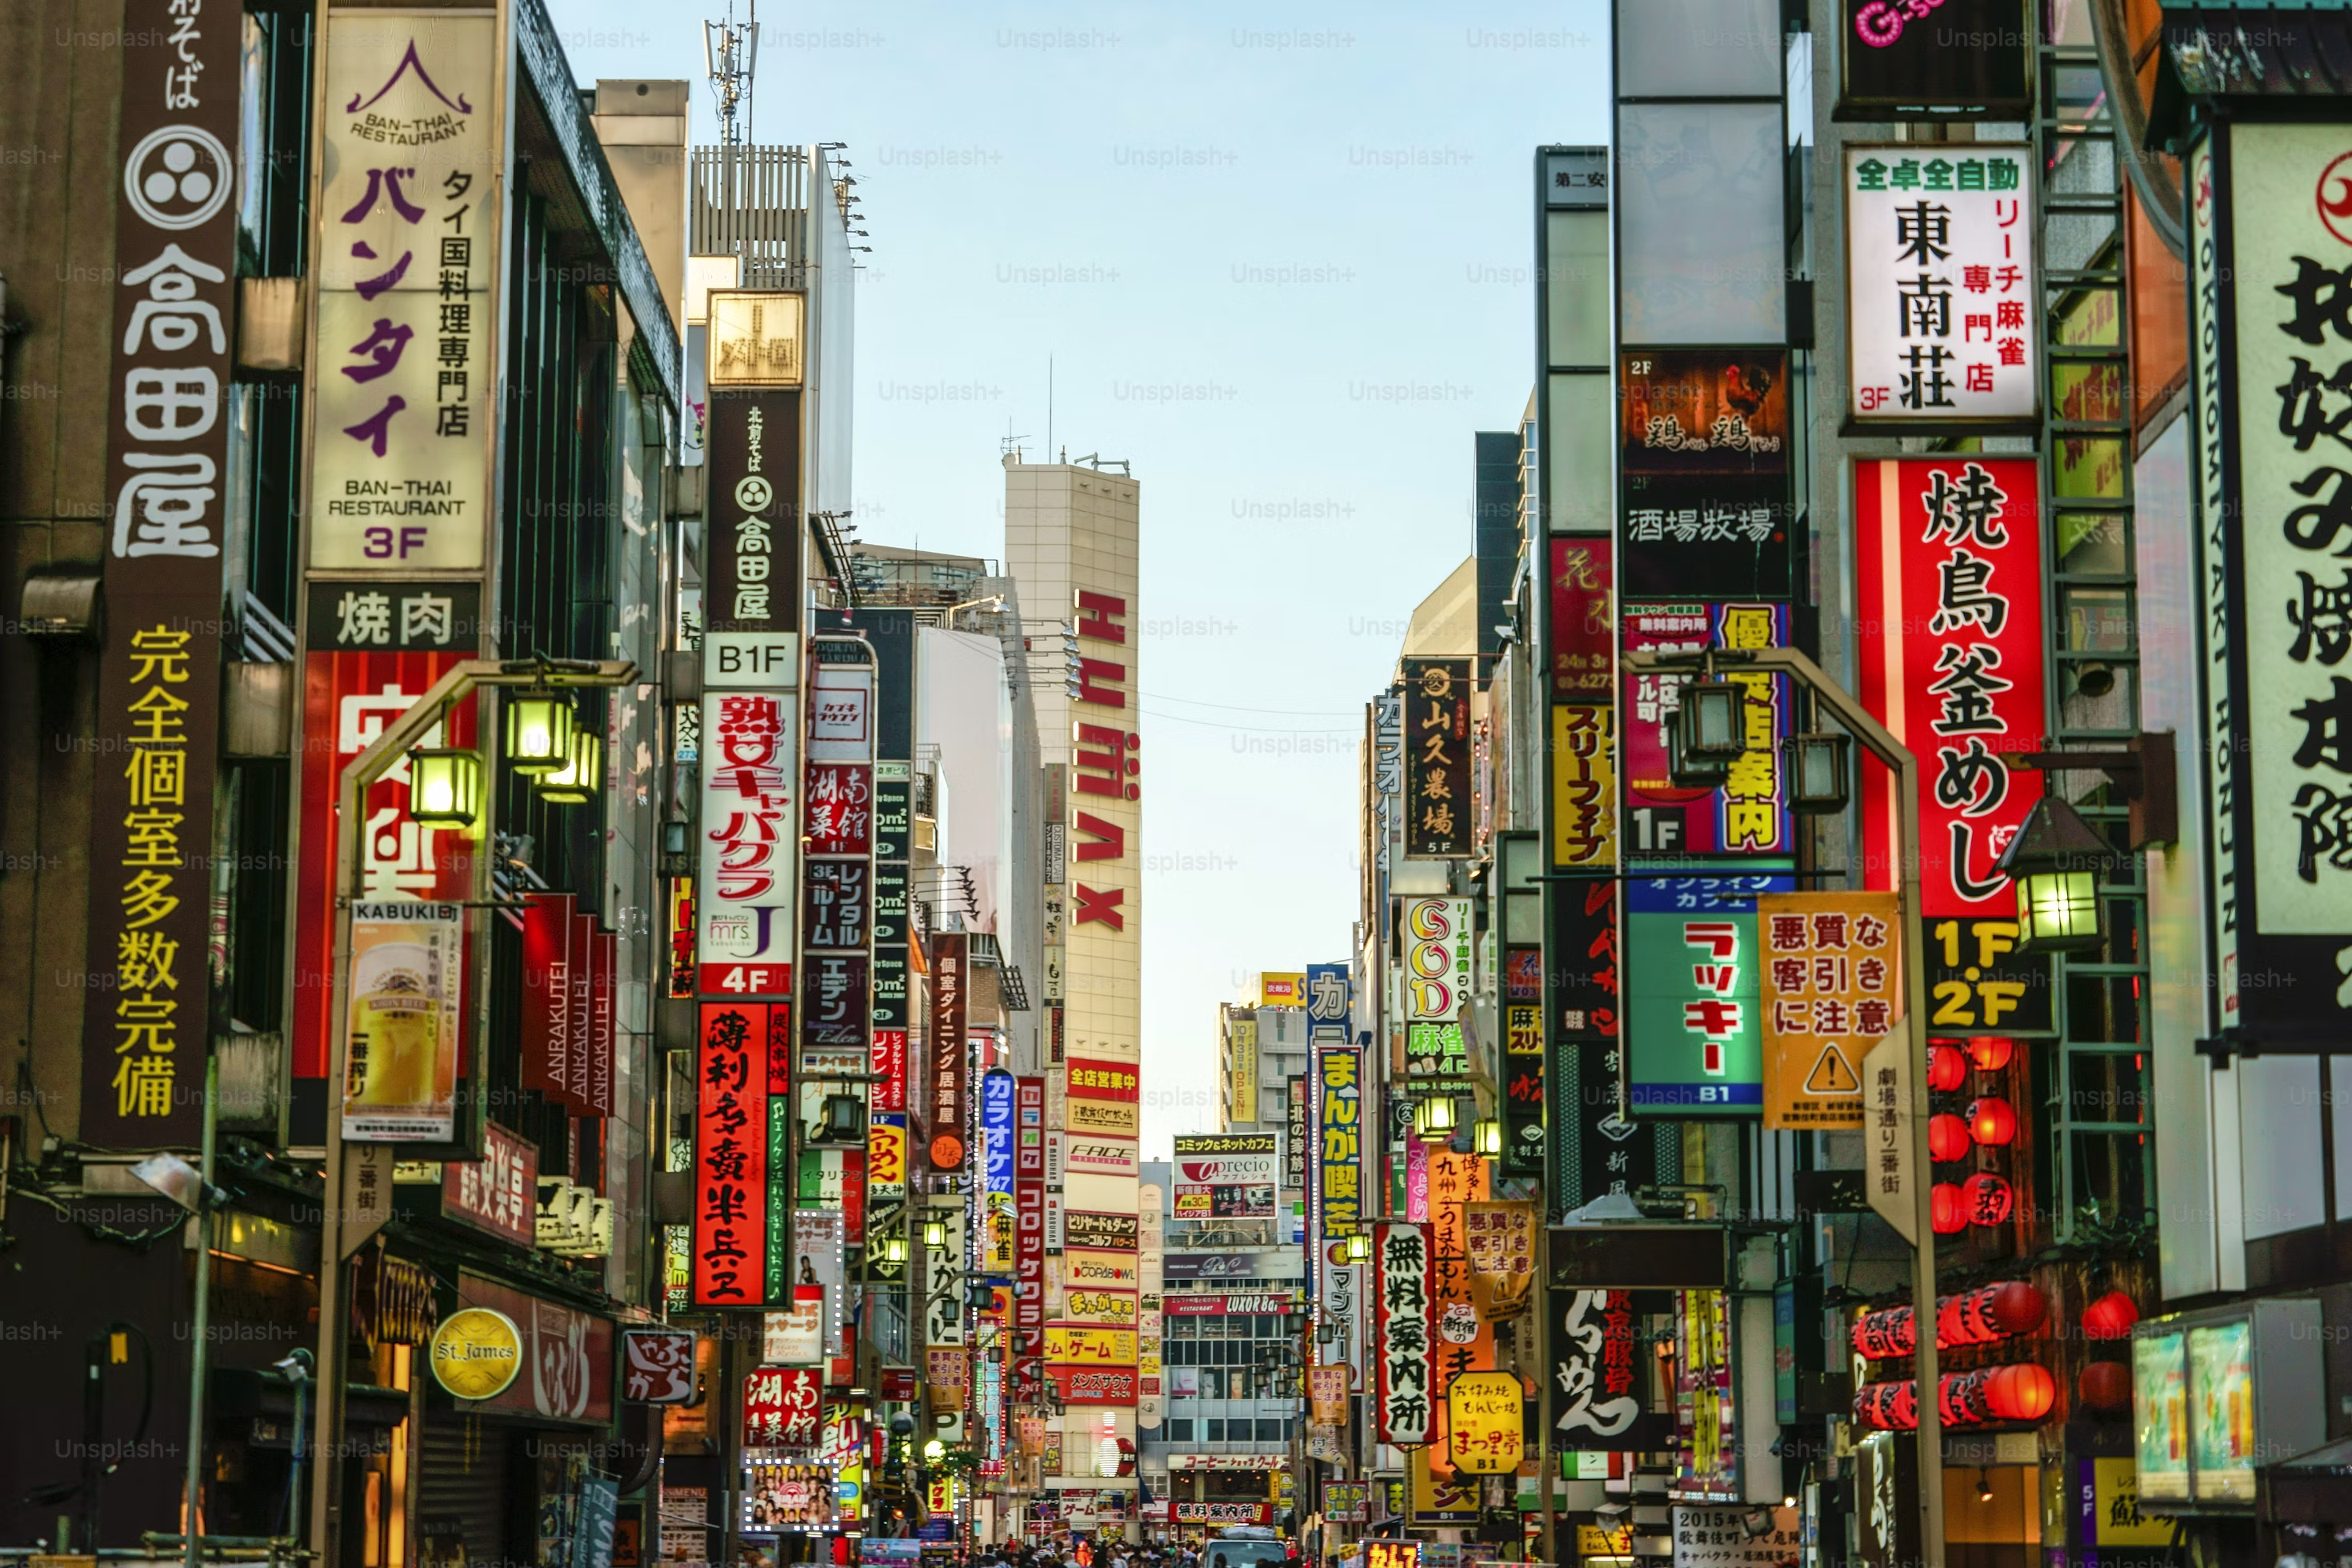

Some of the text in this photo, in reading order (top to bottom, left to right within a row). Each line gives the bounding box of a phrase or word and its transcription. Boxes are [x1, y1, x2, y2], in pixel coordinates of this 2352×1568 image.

[350, 120, 468, 146] RESTAURANT
[364, 113, 453, 133] BAN-THAI
[1856, 158, 2019, 192] 全卓全自動
[1994, 199, 2026, 367] リーチ麻雀
[340, 166, 426, 458] バンタイ
[436, 170, 473, 438] タイ国料理専門店
[1894, 198, 1956, 410] 東南荘
[1963, 265, 1994, 394] 専門店
[1631, 360, 1652, 375] 2F
[112, 243, 226, 558] 高田屋
[1860, 386, 1890, 411] 3F
[748, 406, 762, 472] 北前そば
[346, 480, 452, 496] BAN-THAI
[329, 501, 465, 516] RESTAURANT
[1628, 508, 1776, 542] 酒場牧場
[364, 527, 427, 558] 3F
[735, 515, 771, 619] 高田屋
[336, 590, 453, 646] 焼肉
[1638, 618, 1708, 632] 無料案内所
[720, 646, 785, 673] B1F
[1922, 462, 2013, 902] 焼鳥釜めし
[1421, 701, 1455, 835] 山久農場
[1566, 707, 1607, 863] スリーファイブ
[709, 696, 790, 901] 熟女キャバクラ
[808, 768, 868, 804] 湖南
[1632, 807, 1680, 850] 1F
[878, 844, 891, 854] 5F
[1427, 842, 1452, 853] 5F
[111, 624, 191, 1118] 完全個室多数完備
[812, 885, 834, 946] ルーム
[839, 864, 863, 946] レンタル
[877, 926, 890, 936] 4F
[1456, 902, 1470, 973] リーチ麻雀
[1770, 914, 1889, 952] 悪質な
[1934, 919, 2020, 968] 1F
[722, 966, 768, 993] 4F
[821, 960, 847, 1020] エデン
[1771, 957, 1889, 994] 客引き
[876, 1010, 890, 1019] 3F
[1684, 921, 1743, 1077] ラッキー
[1932, 980, 2026, 1027] 2F
[548, 962, 567, 1083] ANRAKUTEI
[1773, 998, 1891, 1038] に注意
[938, 957, 957, 1124] 個室ダイニング居酒屋
[1408, 1023, 1468, 1056] 麻雀
[350, 1032, 370, 1098] 一番搾り
[1070, 1068, 1136, 1091] 全店営業中
[1699, 1086, 1730, 1102] B1
[986, 1076, 1012, 1173] カラオケ
[1021, 1086, 1041, 1170] カラオケ
[1290, 1106, 1304, 1172] 北の家族
[1877, 1066, 1901, 1195] 劇場通り一番街
[1070, 1145, 1136, 1159] FACE
[1176, 1138, 1274, 1151] コミック&ネットカフェ
[1324, 1054, 1358, 1237] まんが喫茶
[1176, 1185, 1211, 1195] 新宿最大
[1068, 1215, 1137, 1234] ビリヤード&ダーツ
[1175, 1209, 1211, 1218] ハイジアB1
[1468, 1211, 1528, 1231] 悪質な
[996, 1215, 1012, 1262] 麻雀
[1089, 1234, 1112, 1247] ゴルフ
[1470, 1234, 1529, 1253] 客引き
[1471, 1255, 1530, 1275] に注意
[1069, 1291, 1135, 1315] まんが喫茶
[1226, 1295, 1260, 1314] LUXOR
[1069, 1339, 1111, 1358] ゲーム
[1385, 1234, 1427, 1432] 無料案内所
[748, 1370, 818, 1411] 湖南
[1070, 1373, 1132, 1389] メンズサウナ
[1454, 1384, 1510, 1398] お好み焼
[1463, 1401, 1518, 1415] もんじゃ焼
[1184, 1455, 1227, 1469] コーヒー
[1257, 1455, 1279, 1469] クール
[1476, 1458, 1498, 1470] B1
[1063, 1503, 1095, 1516] ゲーム
[1177, 1502, 1254, 1518] 無料案内所
[1439, 1512, 1454, 1520] B1
[1680, 1512, 1740, 1527] 2015年
